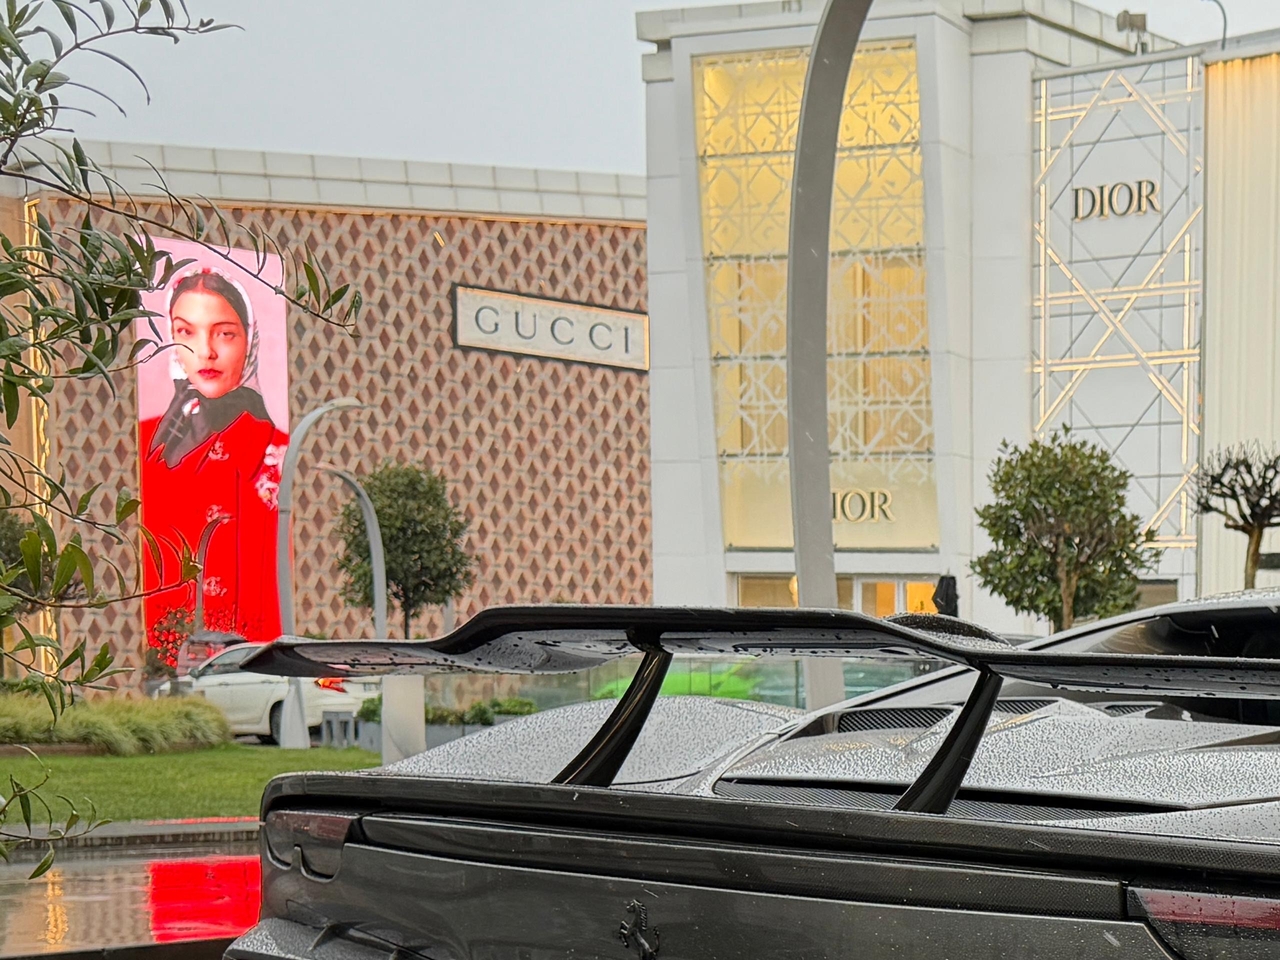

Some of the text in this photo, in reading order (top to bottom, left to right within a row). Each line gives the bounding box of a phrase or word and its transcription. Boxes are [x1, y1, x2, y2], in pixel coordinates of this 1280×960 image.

[1071, 178, 1161, 223] DIOR
[474, 304, 632, 355] GUCCI
[831, 488, 896, 524] IOR
